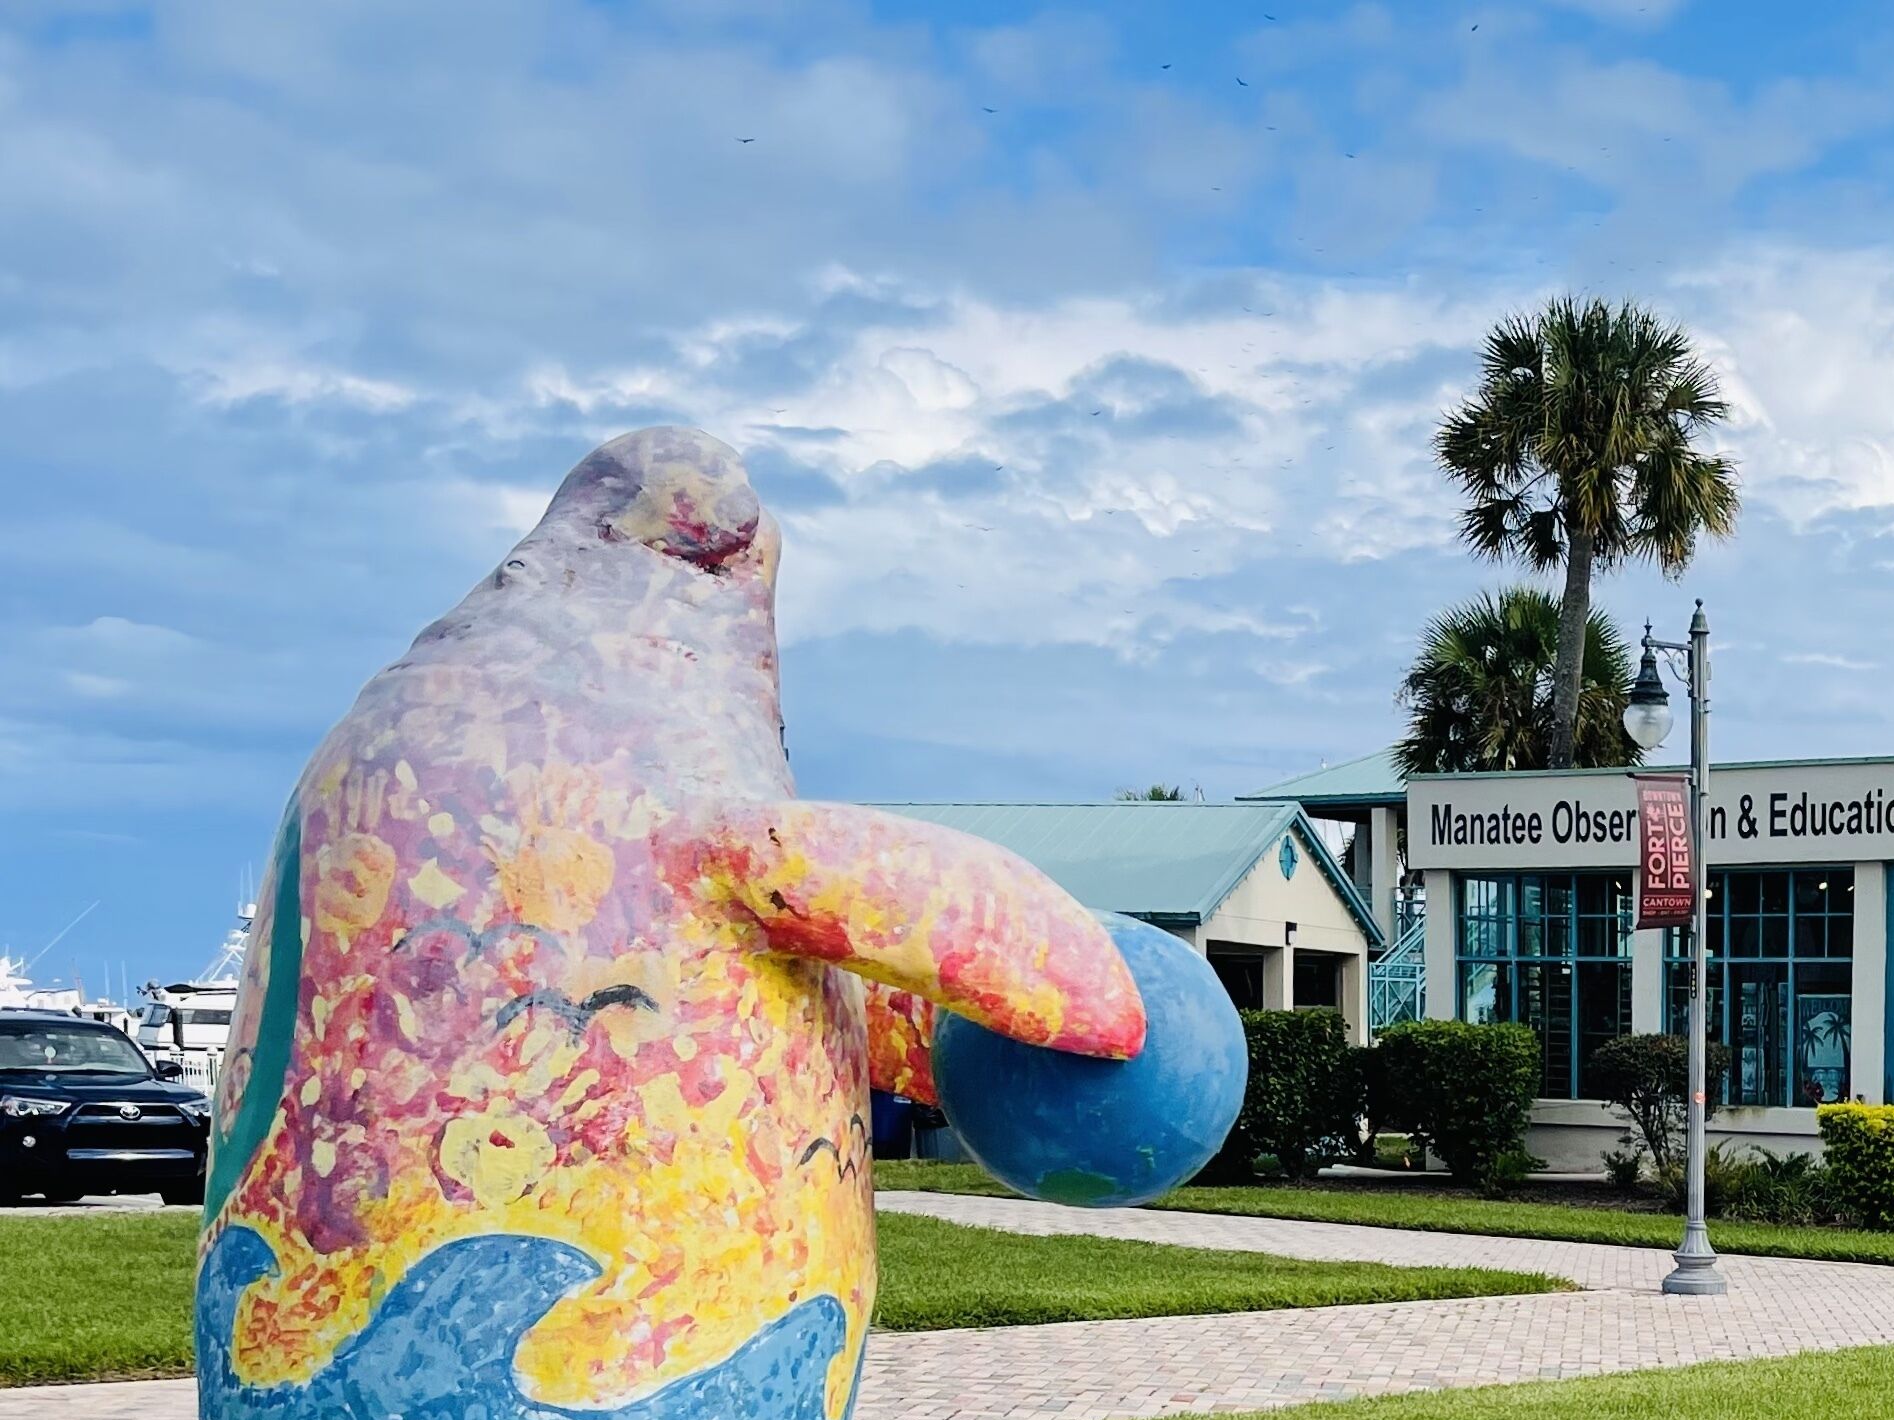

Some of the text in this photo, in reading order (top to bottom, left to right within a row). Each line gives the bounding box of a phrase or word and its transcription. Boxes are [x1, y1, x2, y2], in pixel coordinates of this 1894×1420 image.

[1431, 803, 1543, 846] Manatee
[1551, 800, 1727, 844] Obsern
[1737, 794, 1759, 839] &
[1647, 802, 1690, 889] FORT PIERCE
[1642, 897, 1692, 908] CANTOWN
